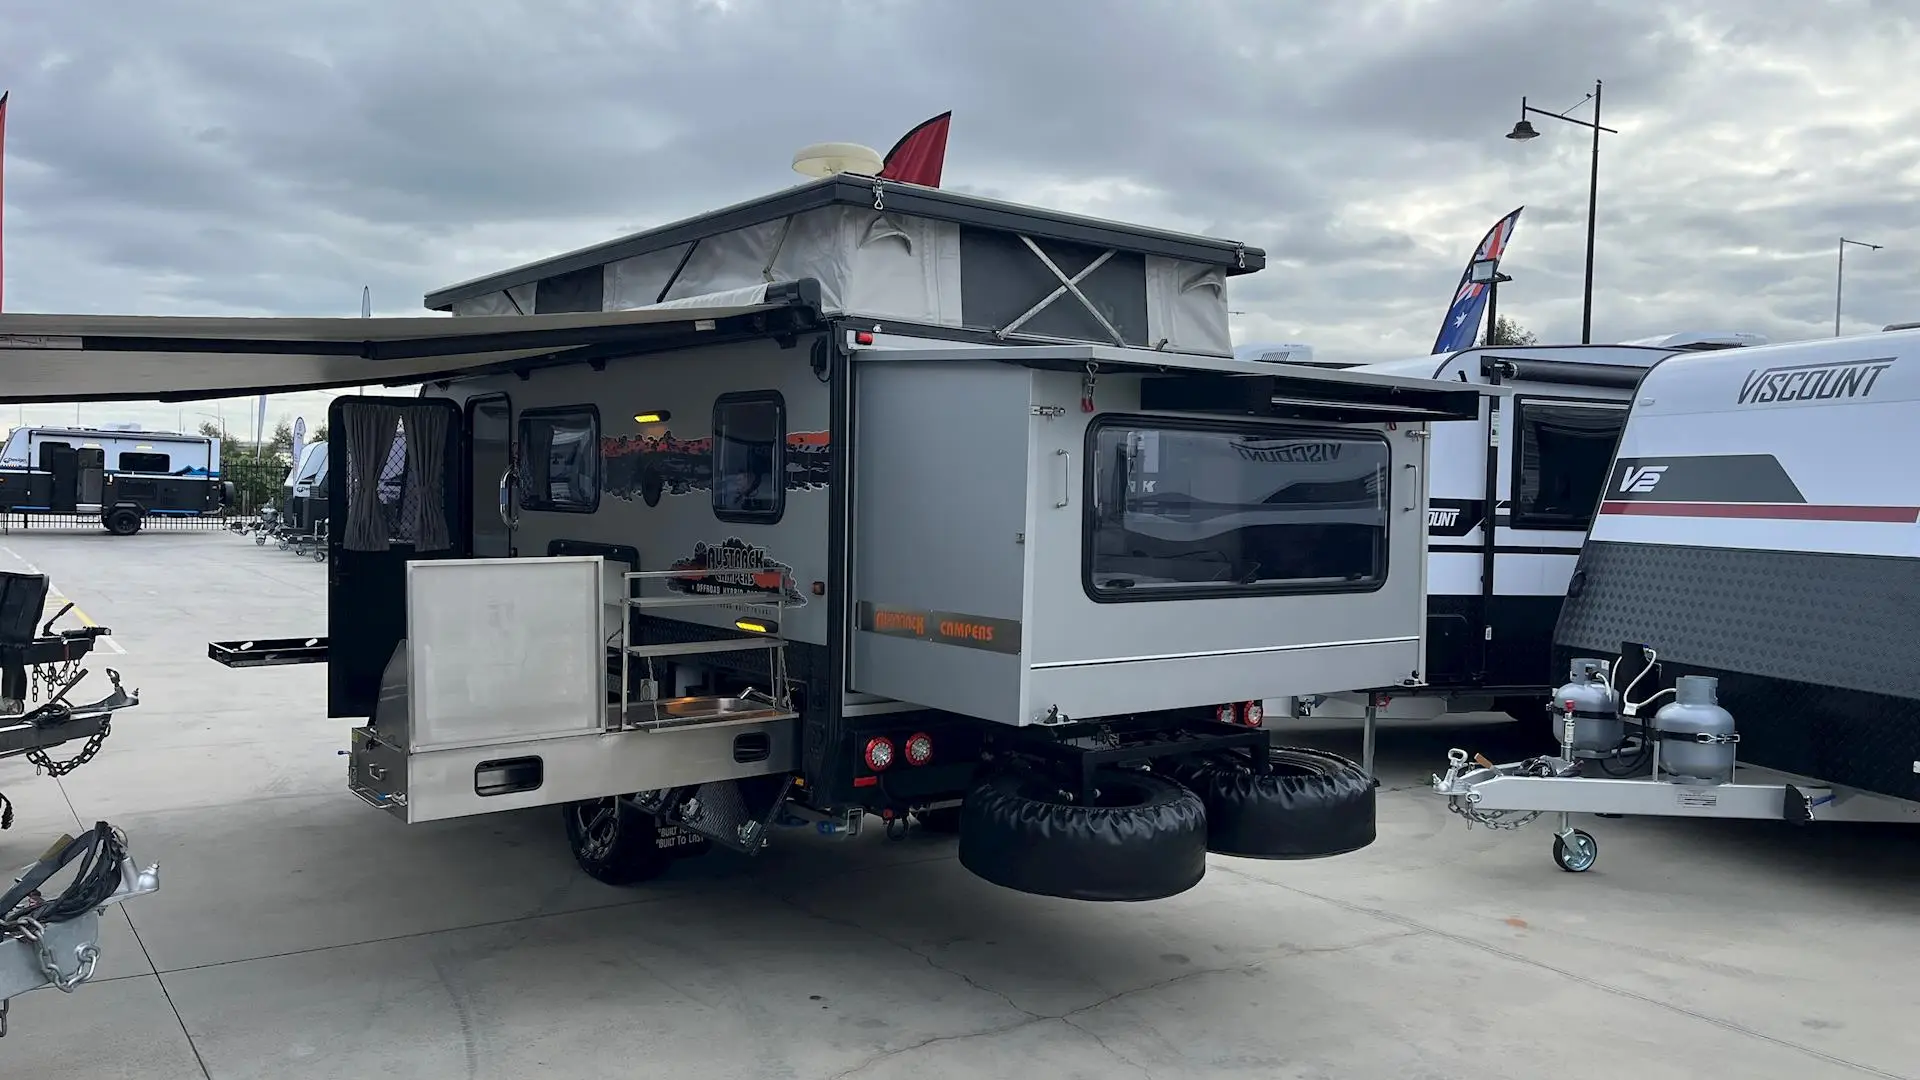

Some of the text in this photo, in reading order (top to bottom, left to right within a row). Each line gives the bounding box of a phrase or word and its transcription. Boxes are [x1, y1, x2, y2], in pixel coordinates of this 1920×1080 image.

[1737, 357, 1898, 404] VISCOUNT
[1619, 466, 1669, 492] V2
[707, 546, 765, 570] AUSTRACK
